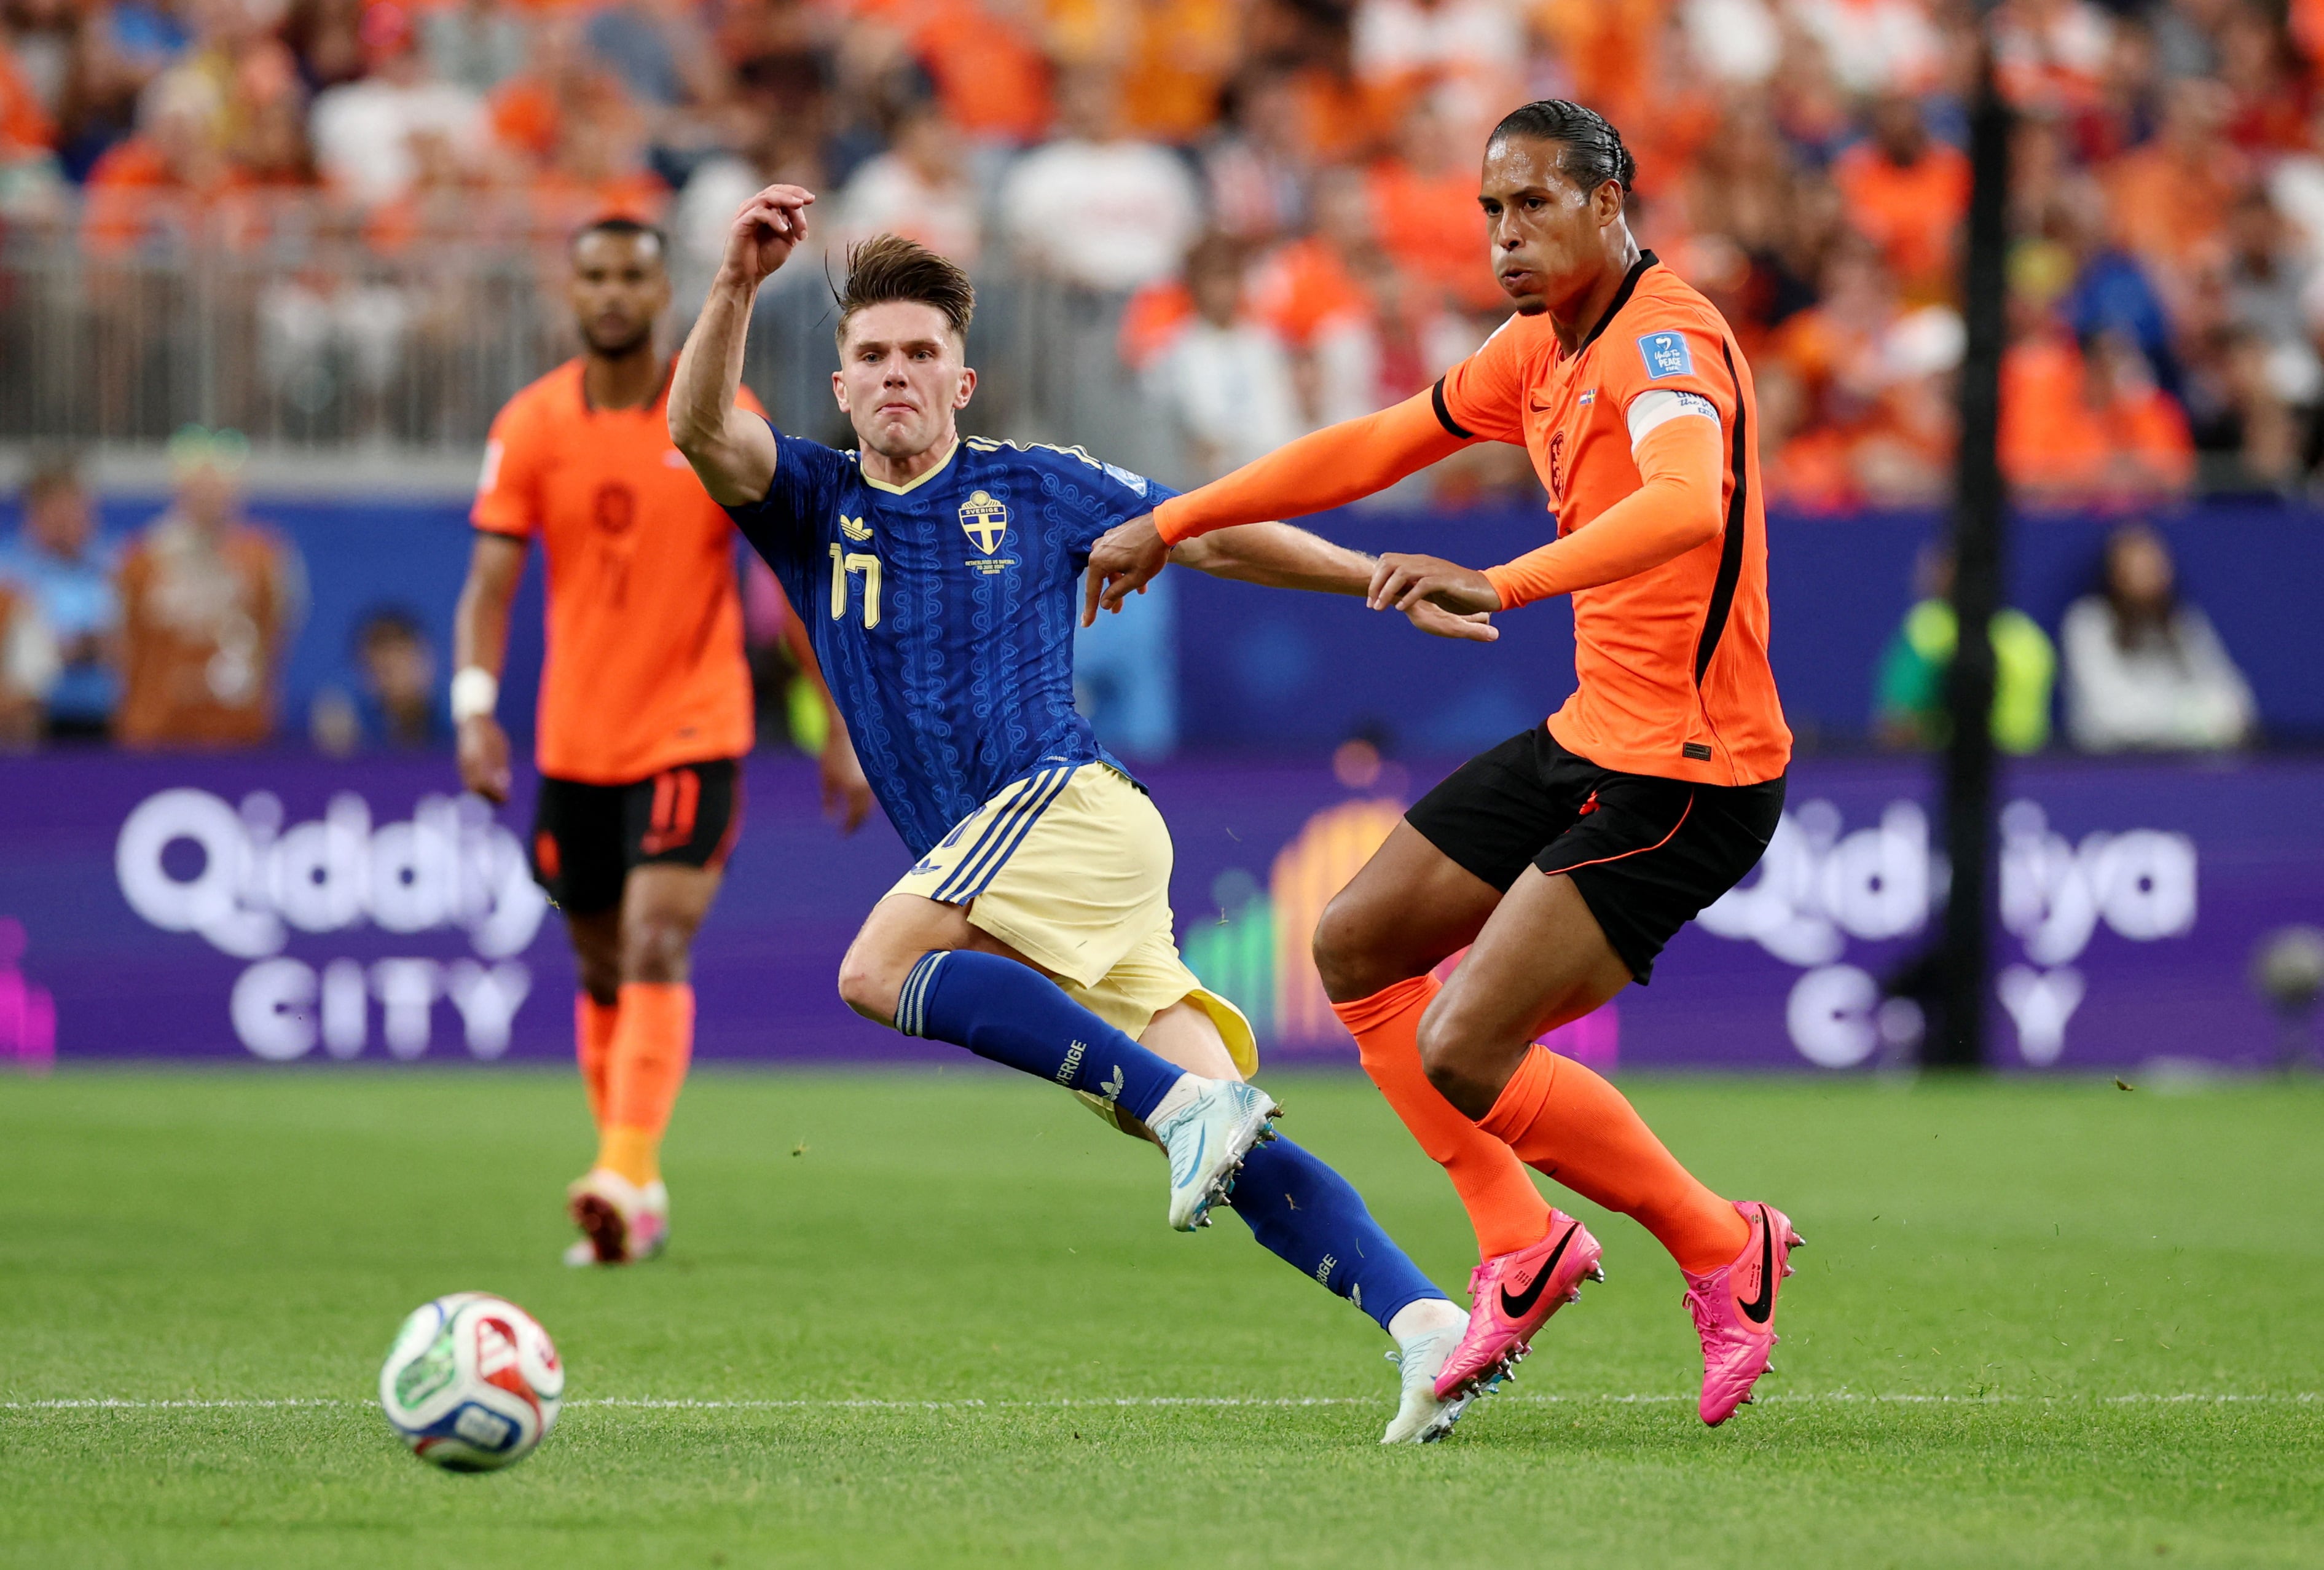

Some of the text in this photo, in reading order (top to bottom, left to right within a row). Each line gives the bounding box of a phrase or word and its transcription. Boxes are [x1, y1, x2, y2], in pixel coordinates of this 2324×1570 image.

[1659, 358, 1681, 368] PEACE
[828, 542, 882, 630] 17
[115, 787, 549, 960] Qiddiy
[230, 957, 532, 1061] CITY
[1055, 1039, 1087, 1085] VERIGE
